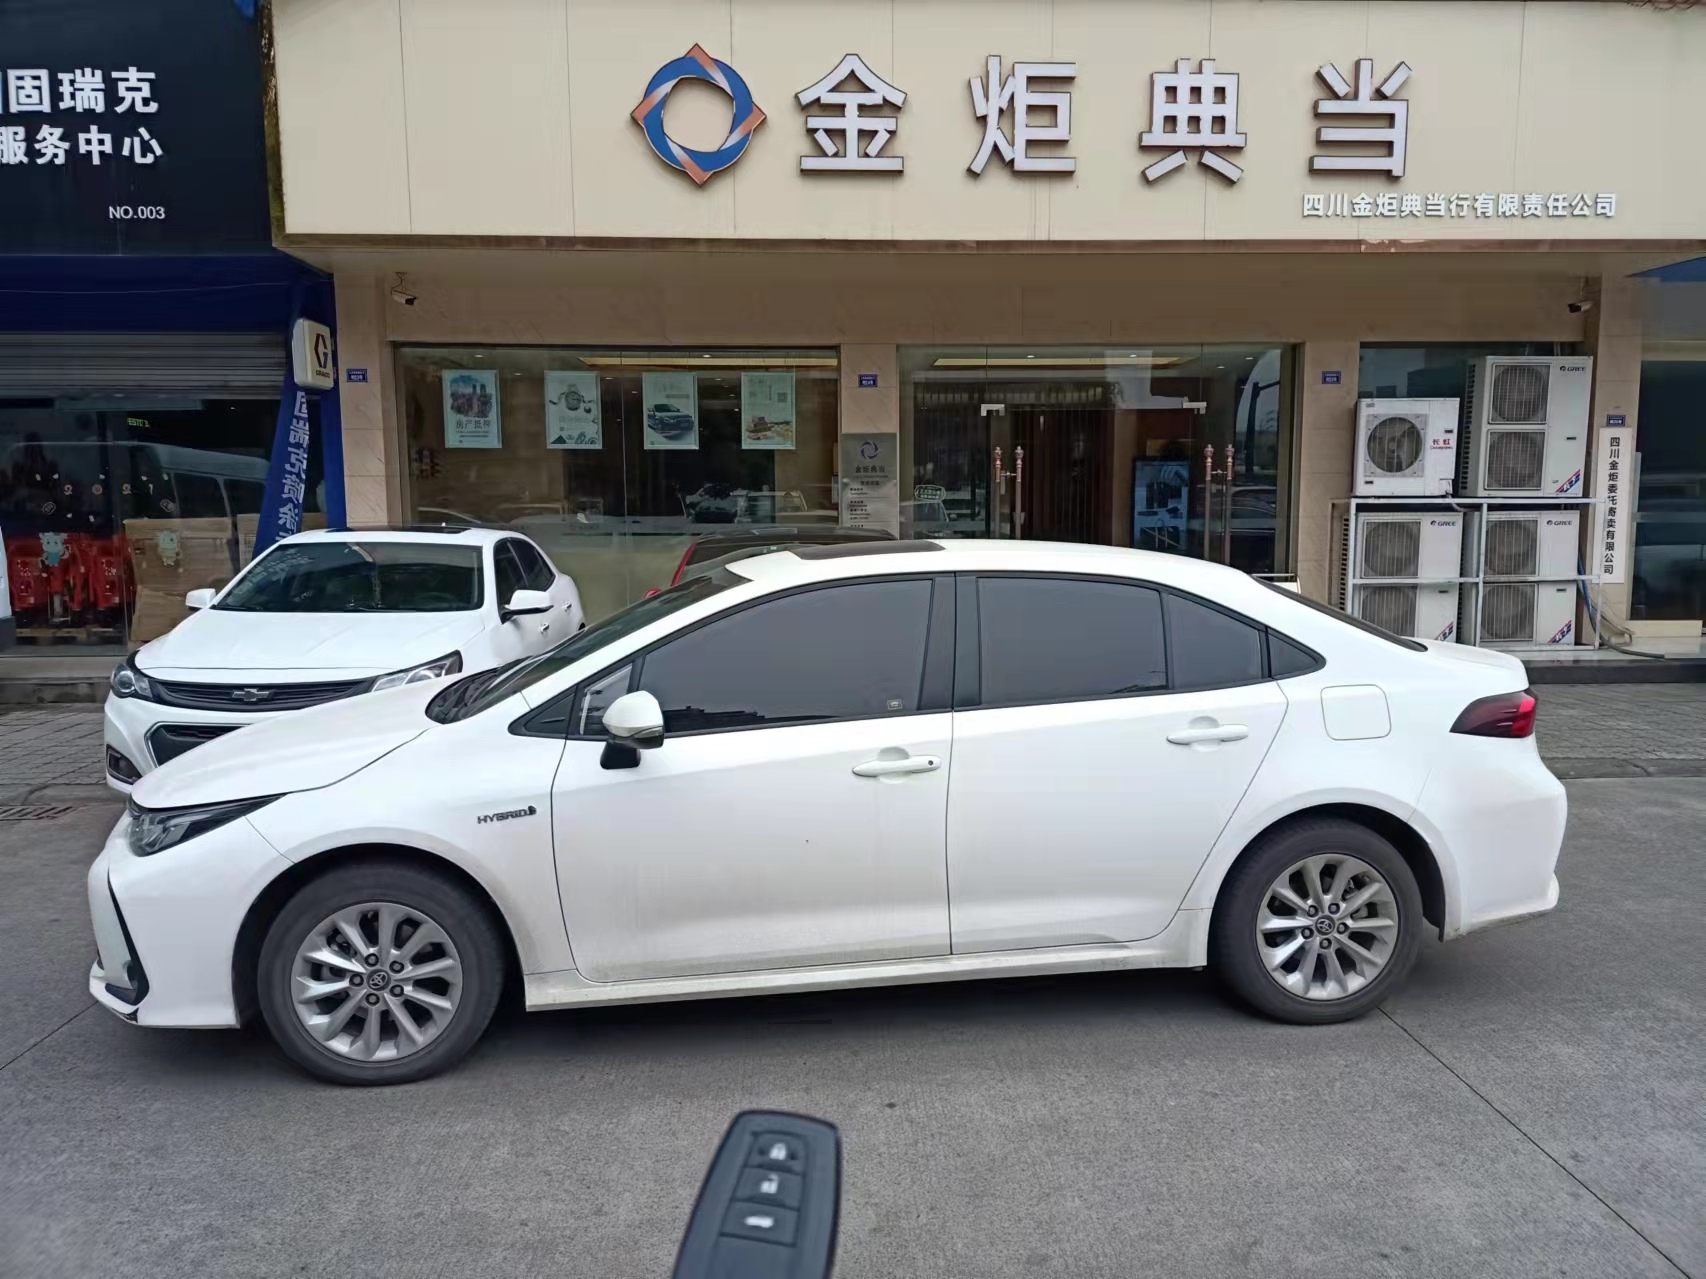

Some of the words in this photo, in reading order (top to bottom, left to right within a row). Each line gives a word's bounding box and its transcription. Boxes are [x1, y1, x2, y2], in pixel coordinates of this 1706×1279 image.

[0, 66, 159, 114] 固瑞克
[795, 53, 1412, 184] 金炬典当
[0, 124, 163, 165] 服务中心
[108, 205, 166, 219] NO.003
[1302, 192, 1617, 217] 四川金炬典当行有限责任公司
[1604, 436, 1620, 575] 四川金炬委托寄卖有限公司
[477, 808, 529, 824] HYBRID
